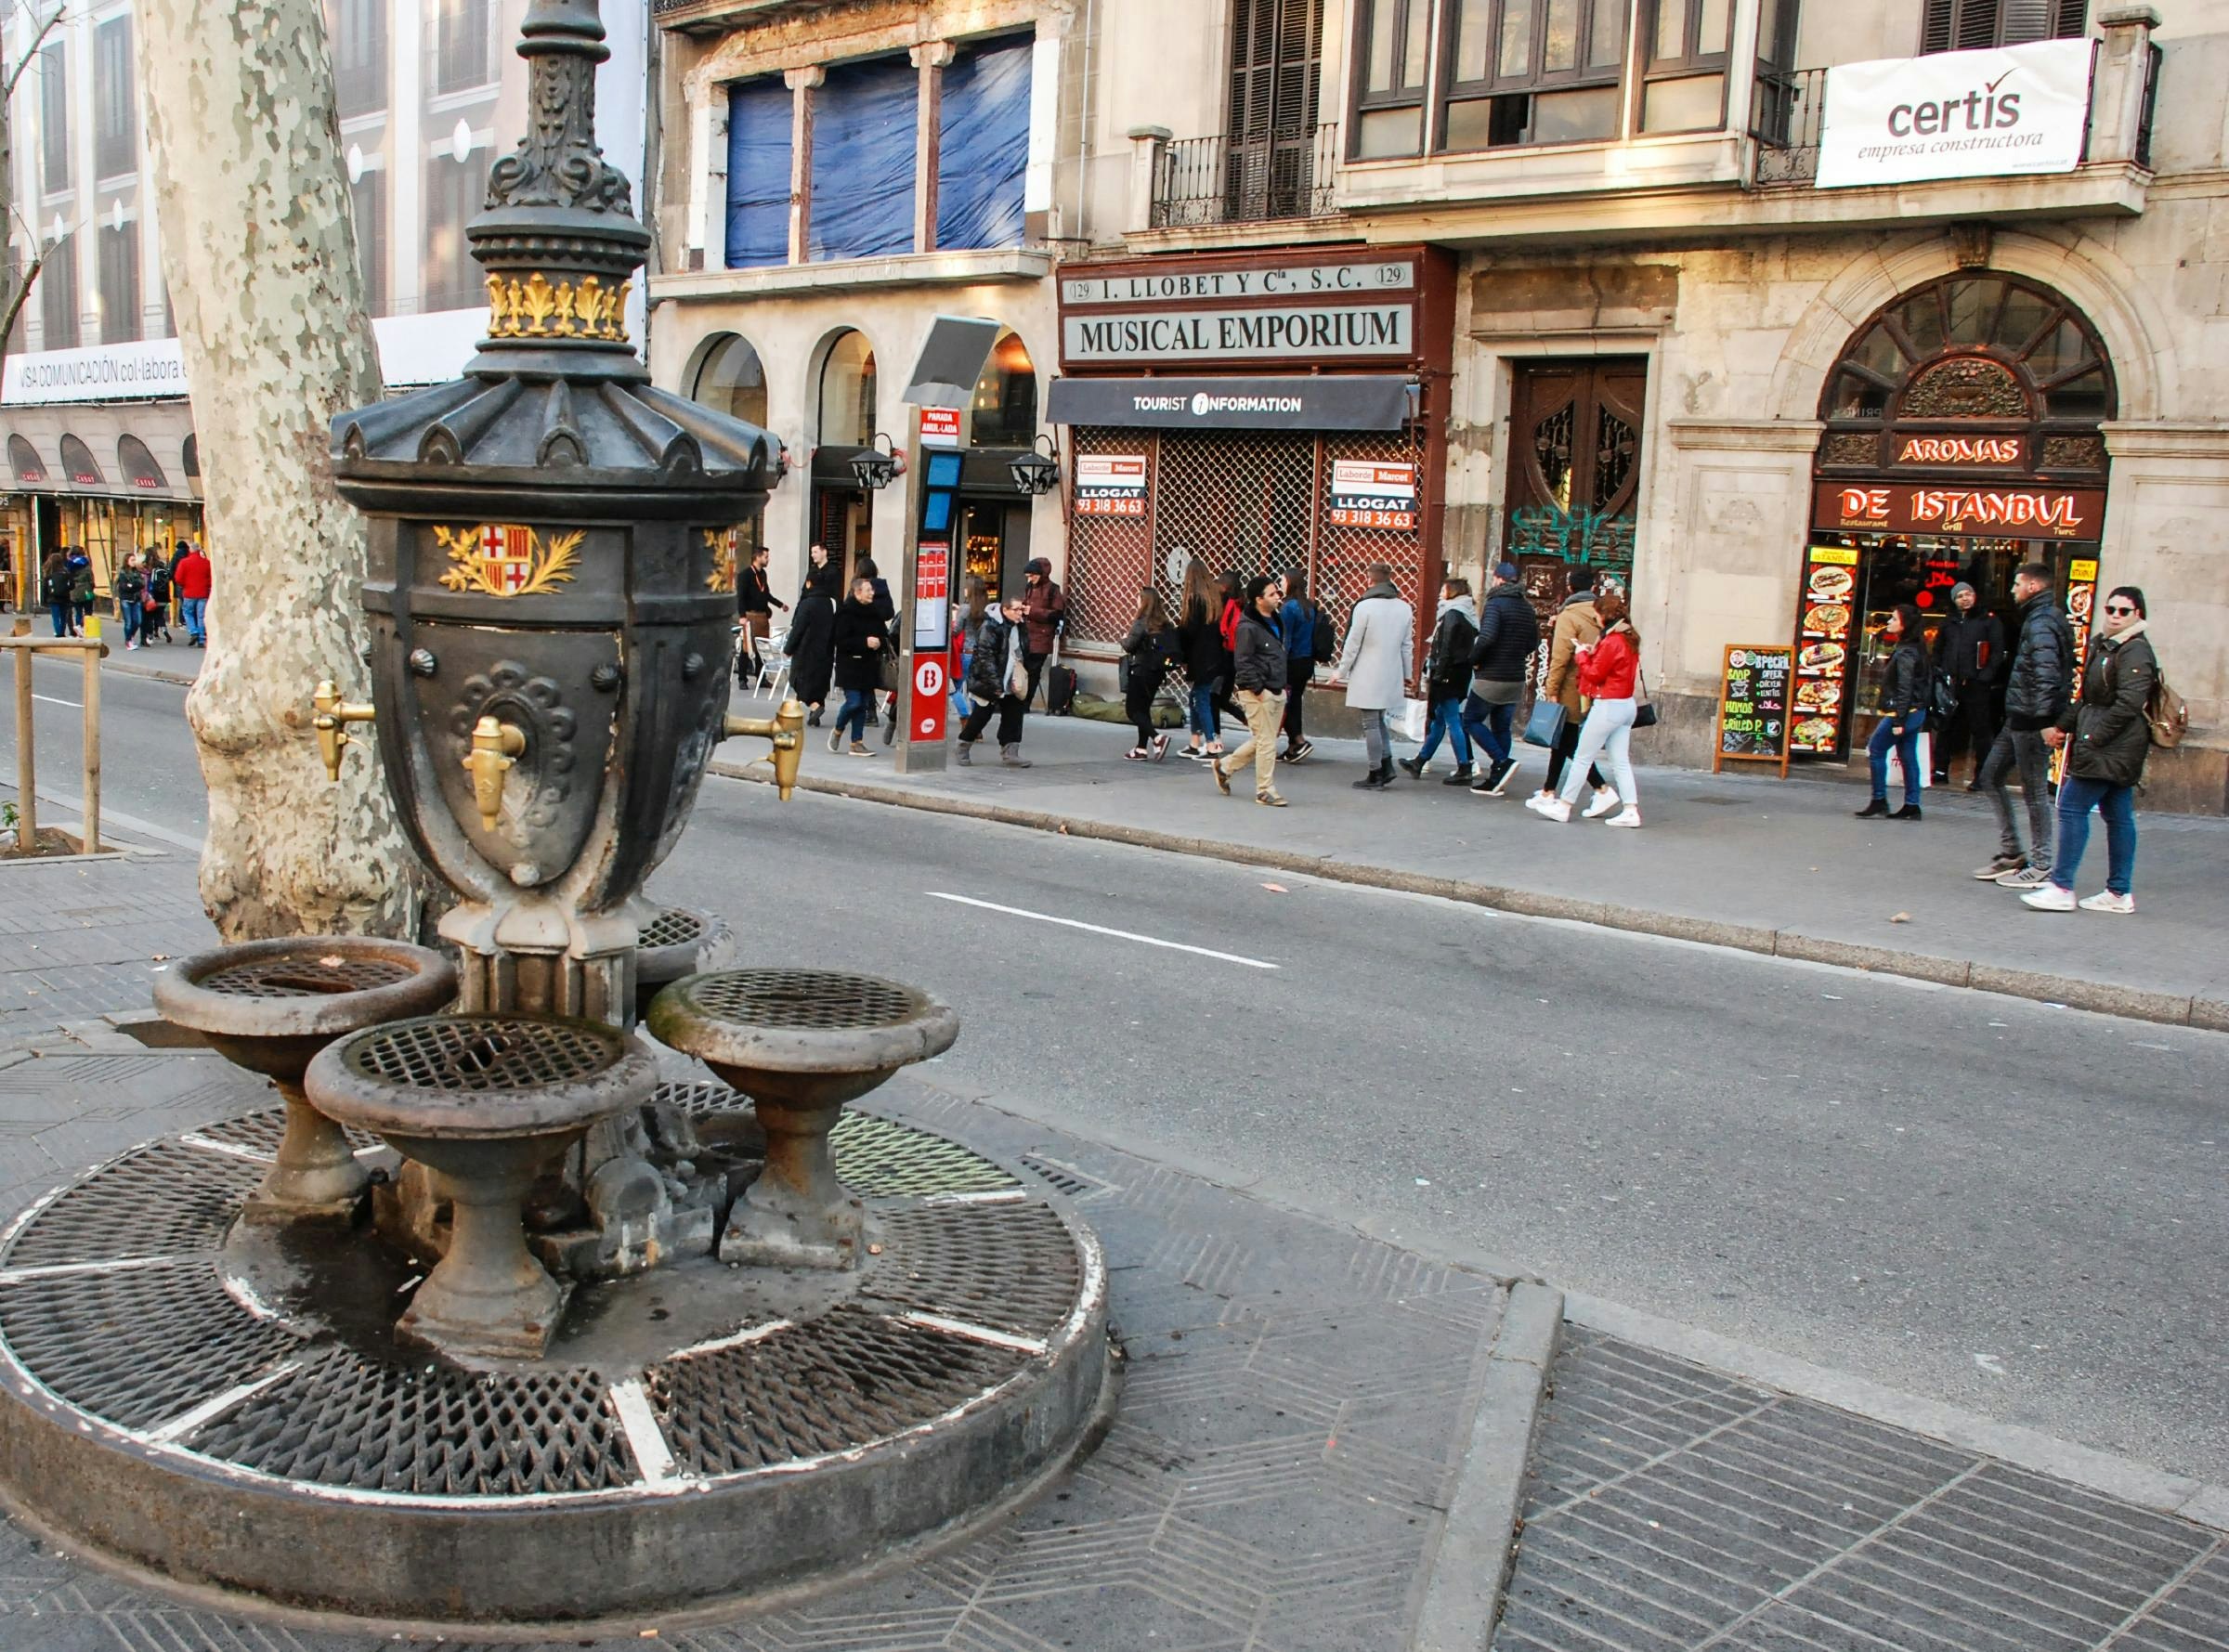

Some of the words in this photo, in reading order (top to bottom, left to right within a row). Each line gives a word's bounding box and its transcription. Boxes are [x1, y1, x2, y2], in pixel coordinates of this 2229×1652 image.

[1888, 89, 2020, 137] certis
[1858, 141, 1924, 163] empresa
[1931, 132, 2043, 153] constructora
[1379, 267, 1401, 283] 129
[1073, 282, 1089, 298] 129
[1103, 280, 1118, 299] I.
[1130, 275, 1224, 298] LLOBET
[1236, 274, 1250, 293] Y
[1080, 318, 1209, 353] MUSICAL
[1217, 310, 1400, 349] EMPORIUM
[39, 356, 118, 386] COMUNICACIÓN
[1133, 397, 1187, 410] TOURIST
[927, 412, 953, 422] PARADA
[1899, 439, 2019, 462] AROMAS
[1339, 469, 1372, 479] Laborde
[1378, 471, 1409, 482] Marcet
[1081, 488, 1141, 498] LLOGAT
[1078, 499, 1090, 511] 93
[1094, 499, 1111, 512] 318
[1114, 500, 1127, 513] 36
[1128, 500, 1141, 514] 63
[1337, 497, 1410, 510] LLOGAT
[1837, 488, 1891, 518] DE
[1911, 490, 2083, 527] ISTANBUL
[1333, 510, 1347, 522] 93
[1350, 510, 1372, 524] 318
[1375, 512, 1391, 526] 36
[1394, 513, 1411, 527] 63
[1840, 518, 1888, 527] Restaurant
[1942, 522, 1962, 531] Grill
[2053, 527, 2076, 536] Turc
[924, 670, 936, 688] B
